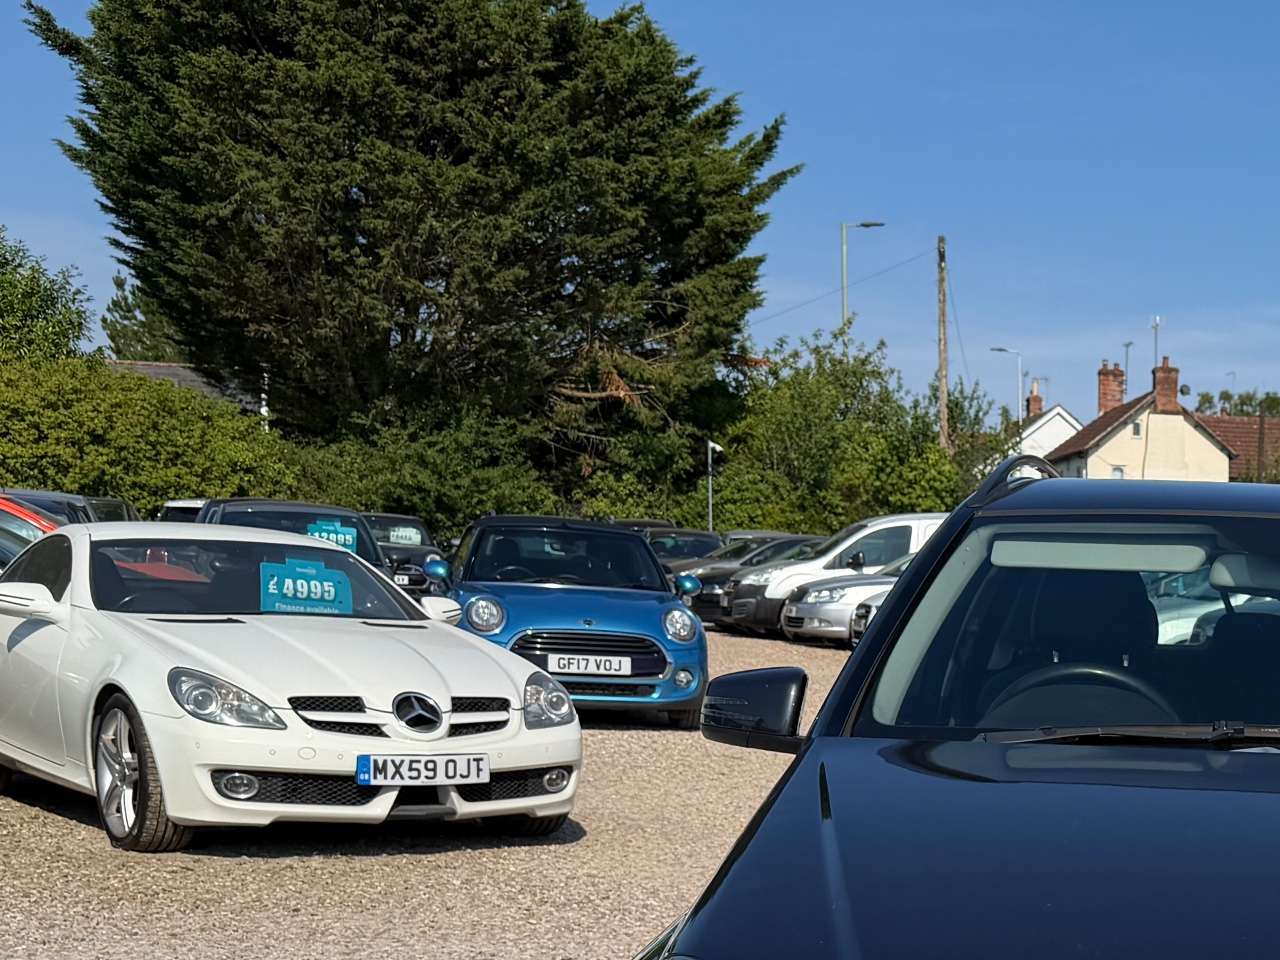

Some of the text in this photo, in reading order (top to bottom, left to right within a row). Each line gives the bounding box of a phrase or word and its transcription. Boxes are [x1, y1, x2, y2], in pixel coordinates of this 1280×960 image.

[557, 656, 622, 673] GF17 VOJ
[372, 758, 438, 781] MX59
